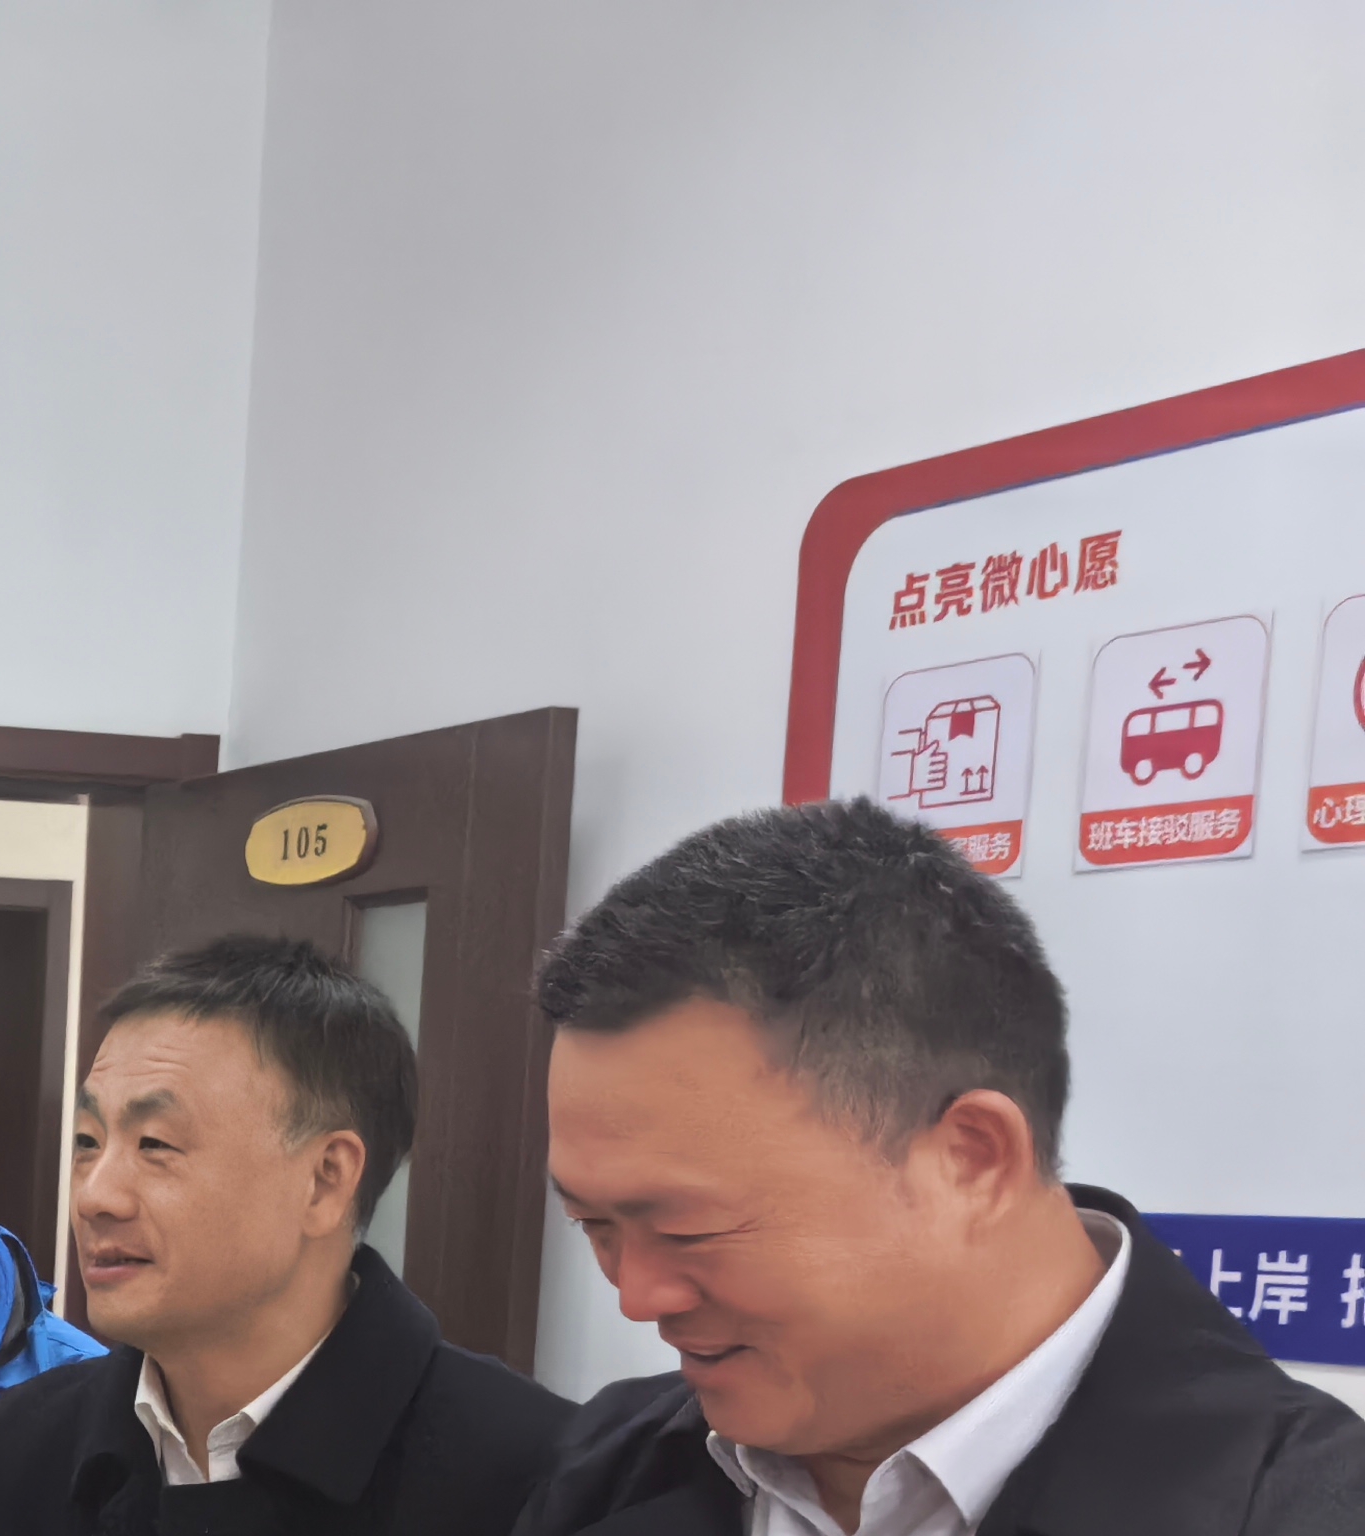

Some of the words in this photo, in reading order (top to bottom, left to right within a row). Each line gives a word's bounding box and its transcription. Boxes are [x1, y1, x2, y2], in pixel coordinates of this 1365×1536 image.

[888, 529, 1123, 631] 点亮微心愿
[281, 823, 329, 861] 105
[1086, 807, 1243, 852] 班车接驳服务
[1171, 1248, 1309, 1326] 上岸
